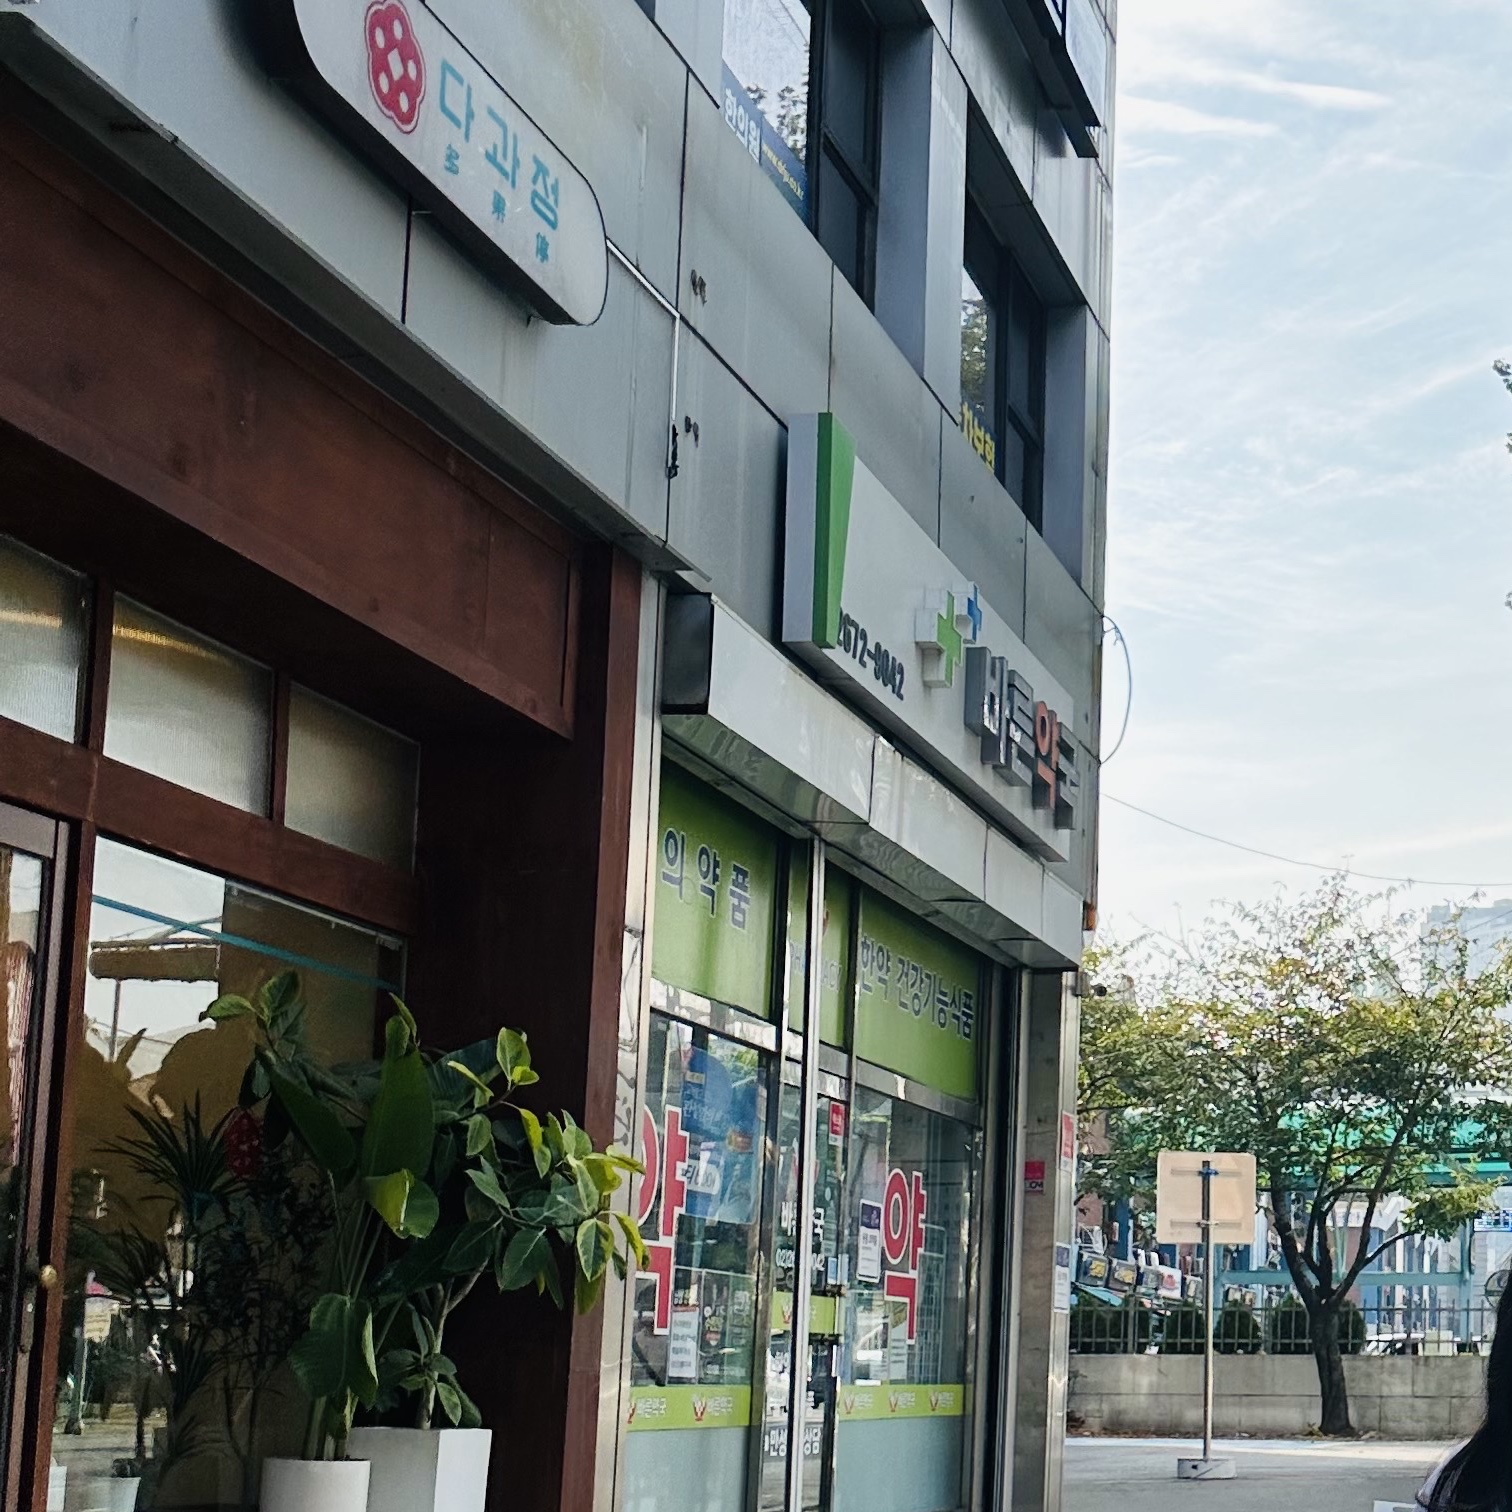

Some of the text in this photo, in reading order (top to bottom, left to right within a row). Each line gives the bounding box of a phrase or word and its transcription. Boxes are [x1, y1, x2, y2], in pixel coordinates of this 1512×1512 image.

[438, 58, 560, 231] 다과정
[725, 87, 761, 163] 한의원
[965, 647, 1080, 830] 바른약국
[661, 828, 752, 935] 의약품
[860, 933, 975, 1041] 한약 건강기능식품
[638, 1104, 690, 1335] 약
[882, 1168, 927, 1345] 약
